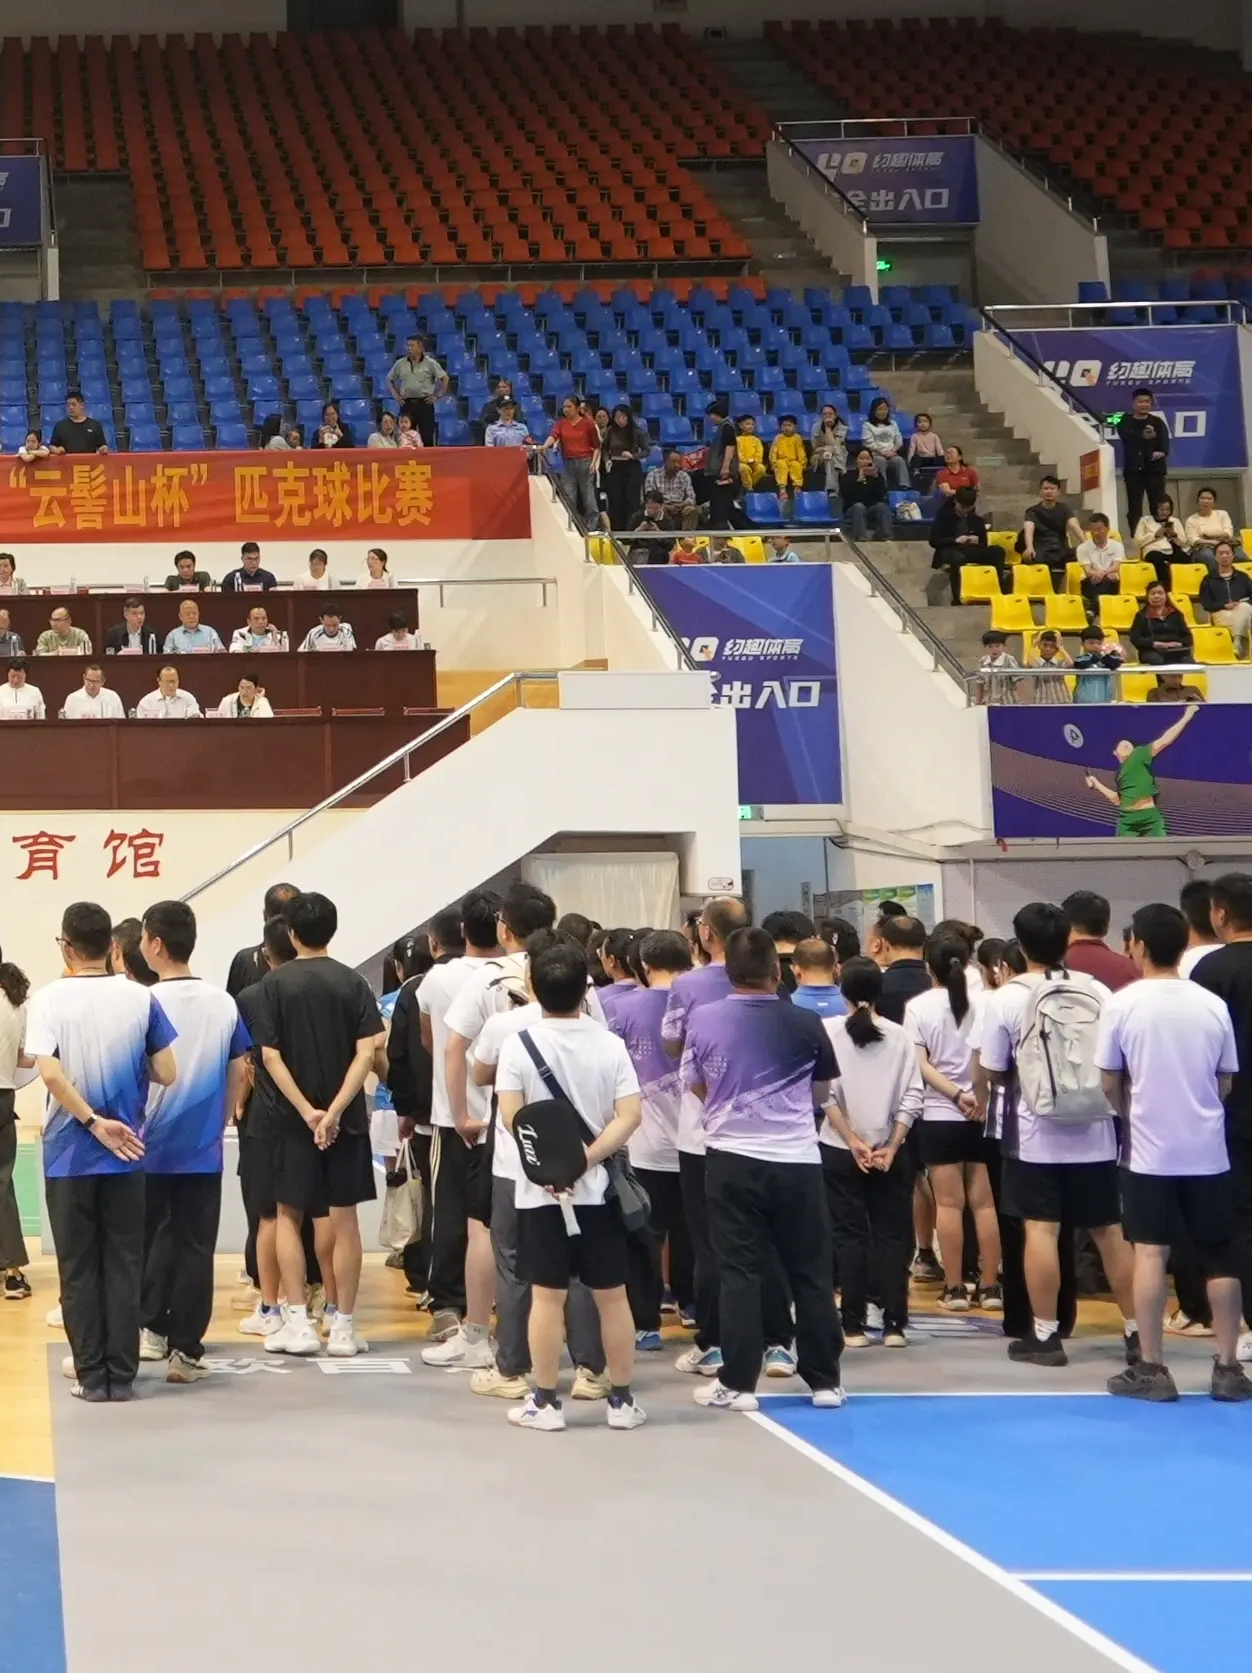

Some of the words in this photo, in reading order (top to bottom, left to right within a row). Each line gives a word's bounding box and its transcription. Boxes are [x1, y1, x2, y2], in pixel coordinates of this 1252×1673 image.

[832, 188, 950, 212] 全出入口
[1106, 360, 1196, 379] 约趣体育
[723, 638, 804, 655] 约趣体育
[711, 681, 821, 709] 出入口
